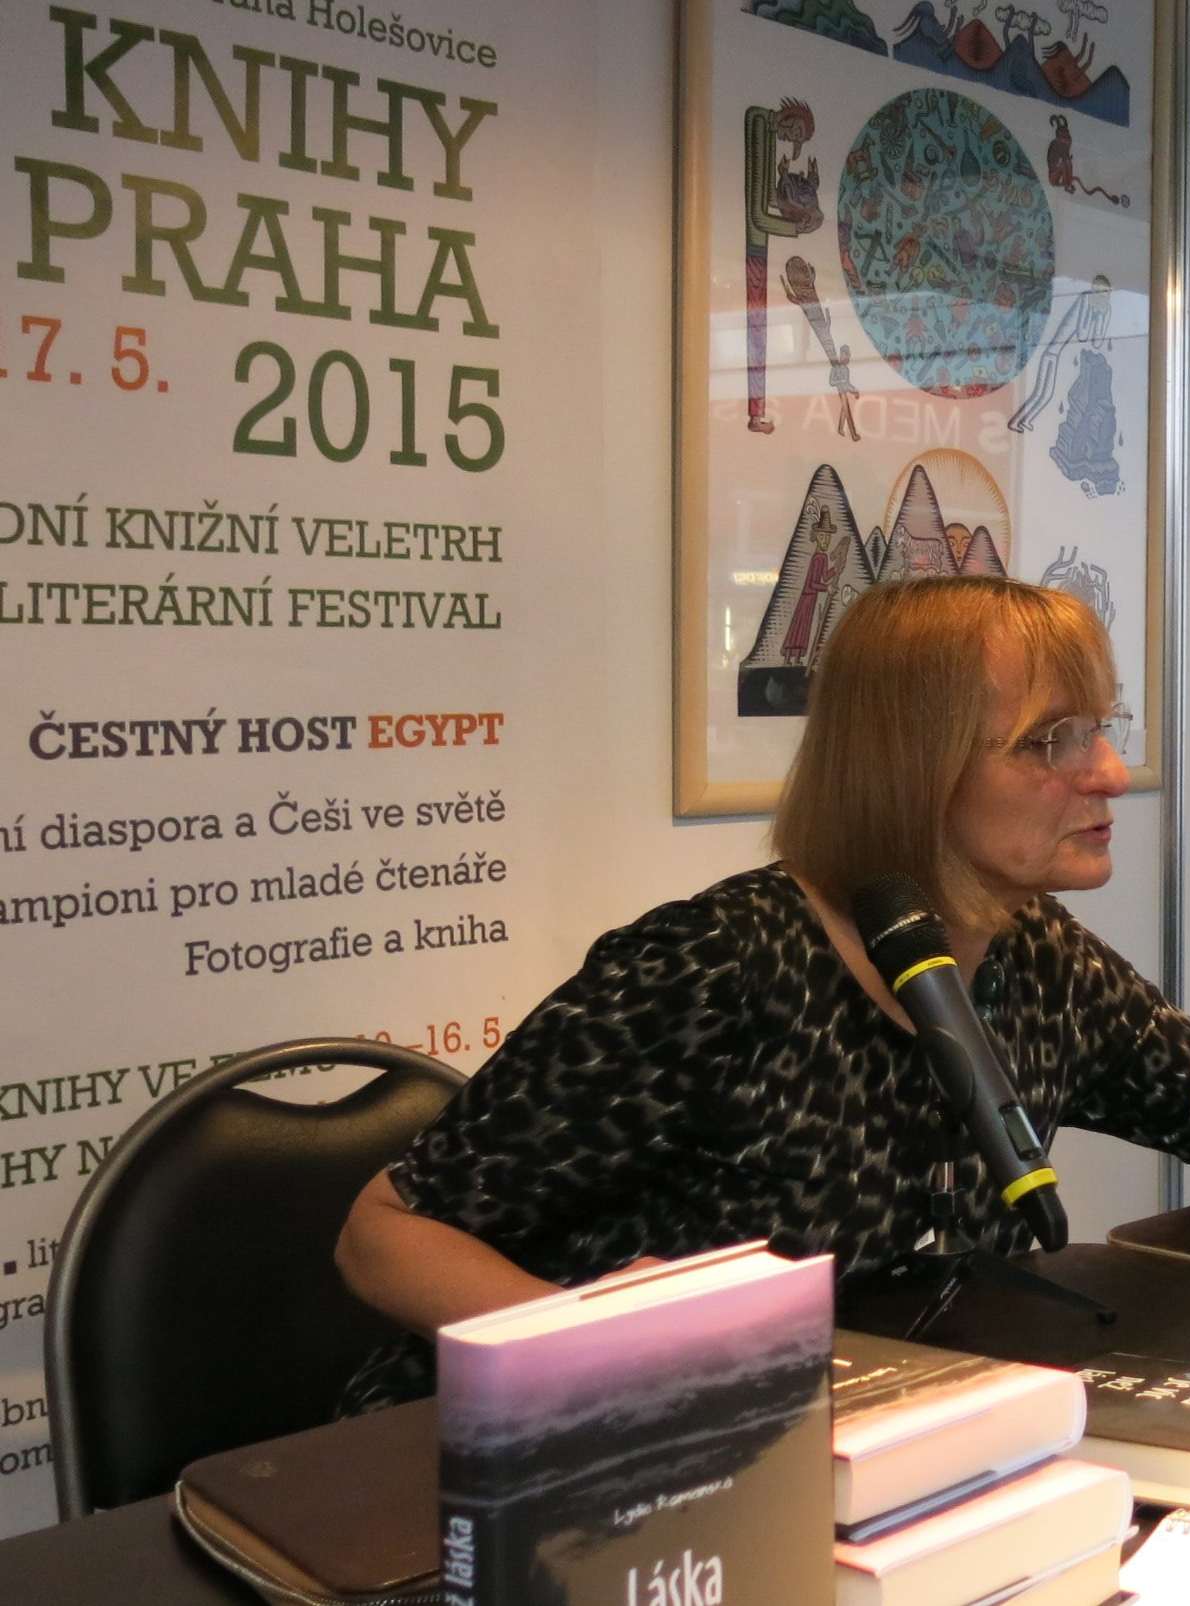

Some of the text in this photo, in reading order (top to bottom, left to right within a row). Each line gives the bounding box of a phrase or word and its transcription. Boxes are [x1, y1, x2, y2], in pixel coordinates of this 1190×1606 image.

[306, 0, 497, 67] Holešovice
[49, 5, 498, 201] KNIHY
[14, 156, 499, 339] PRAHA
[111, 326, 168, 393] 5.
[233, 341, 505, 473] 2015
[105, 500, 279, 554] KNIŽNÍ
[292, 516, 502, 562] VELETRH
[0, 573, 501, 630] LITERÁRNÍ FESTIVAL
[29, 707, 504, 759] ČESTNÝ HOST EGYPT
[41, 808, 223, 852] diaspora
[235, 810, 256, 837] a
[269, 792, 352, 835] Češi
[362, 802, 404, 828] ve
[416, 790, 506, 826] světě
[170, 878, 239, 917] pro
[250, 860, 364, 903] mladé
[376, 852, 507, 893] čtenáře
[185, 914, 508, 975] Fotografie a kniha
[443, 1516, 474, 1588] láska
[626, 1549, 723, 1606] Láska
